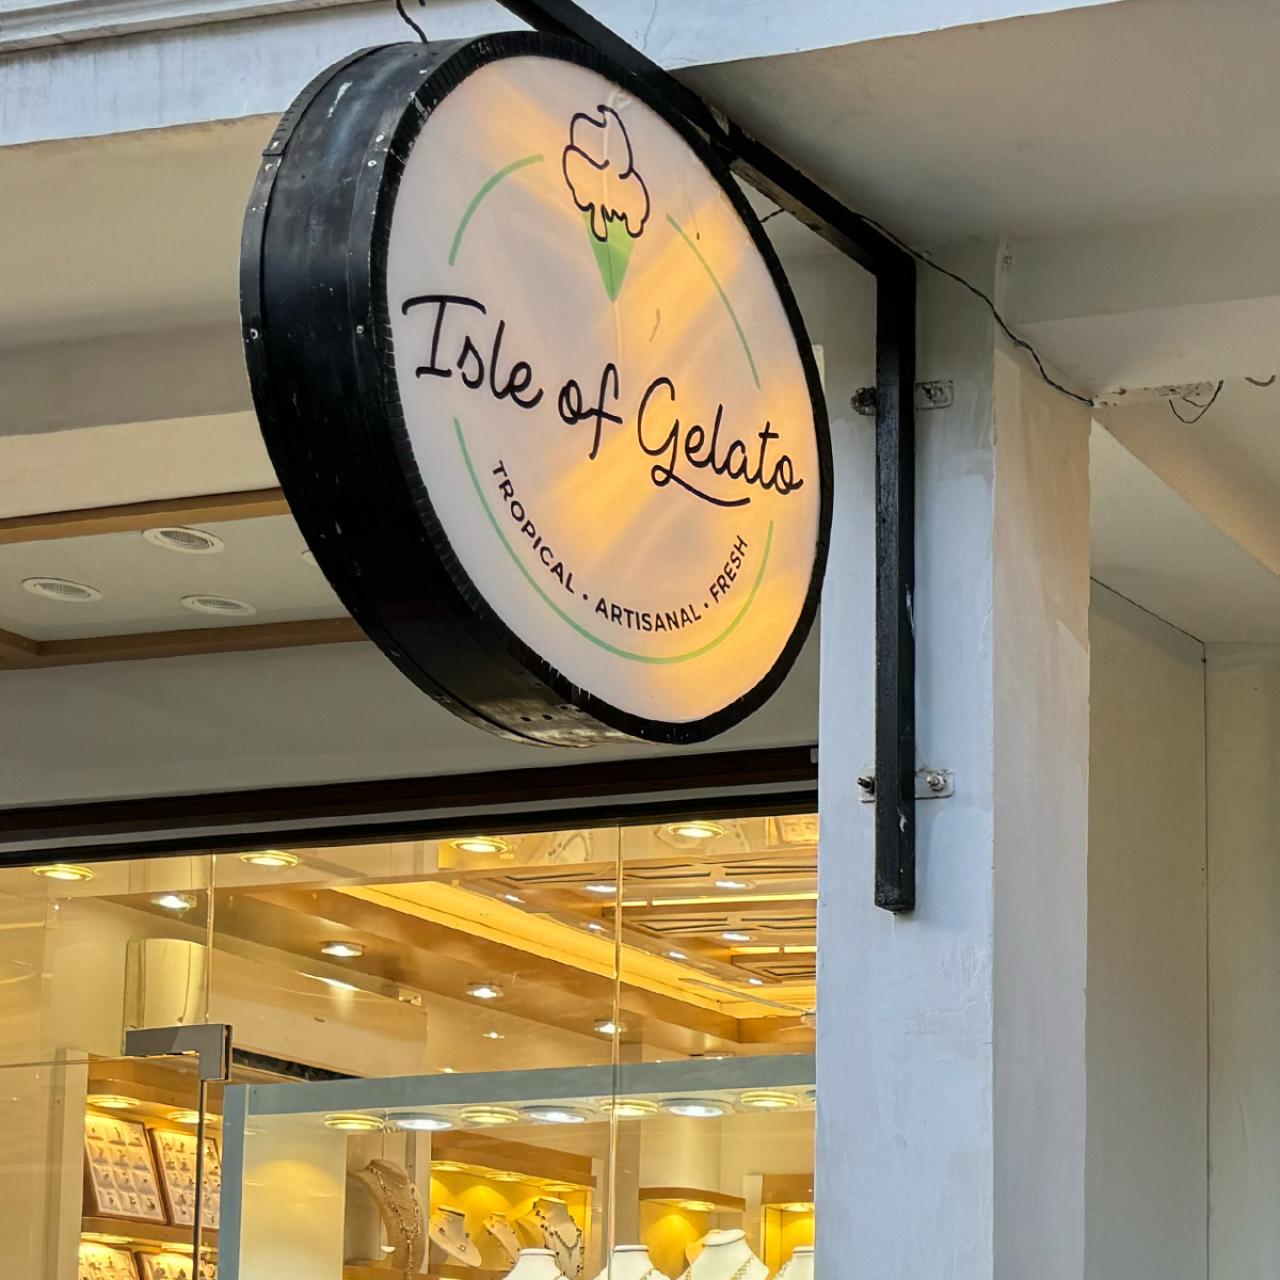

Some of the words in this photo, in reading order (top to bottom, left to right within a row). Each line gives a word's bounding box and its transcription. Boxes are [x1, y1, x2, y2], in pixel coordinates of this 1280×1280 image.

[402, 294, 544, 410] Isle
[557, 363, 623, 460] of
[638, 377, 804, 508] Gelato
[491, 459, 578, 595] TROPICAL
[595, 597, 704, 633] ARTISANAL
[709, 534, 749, 603] FRESH
